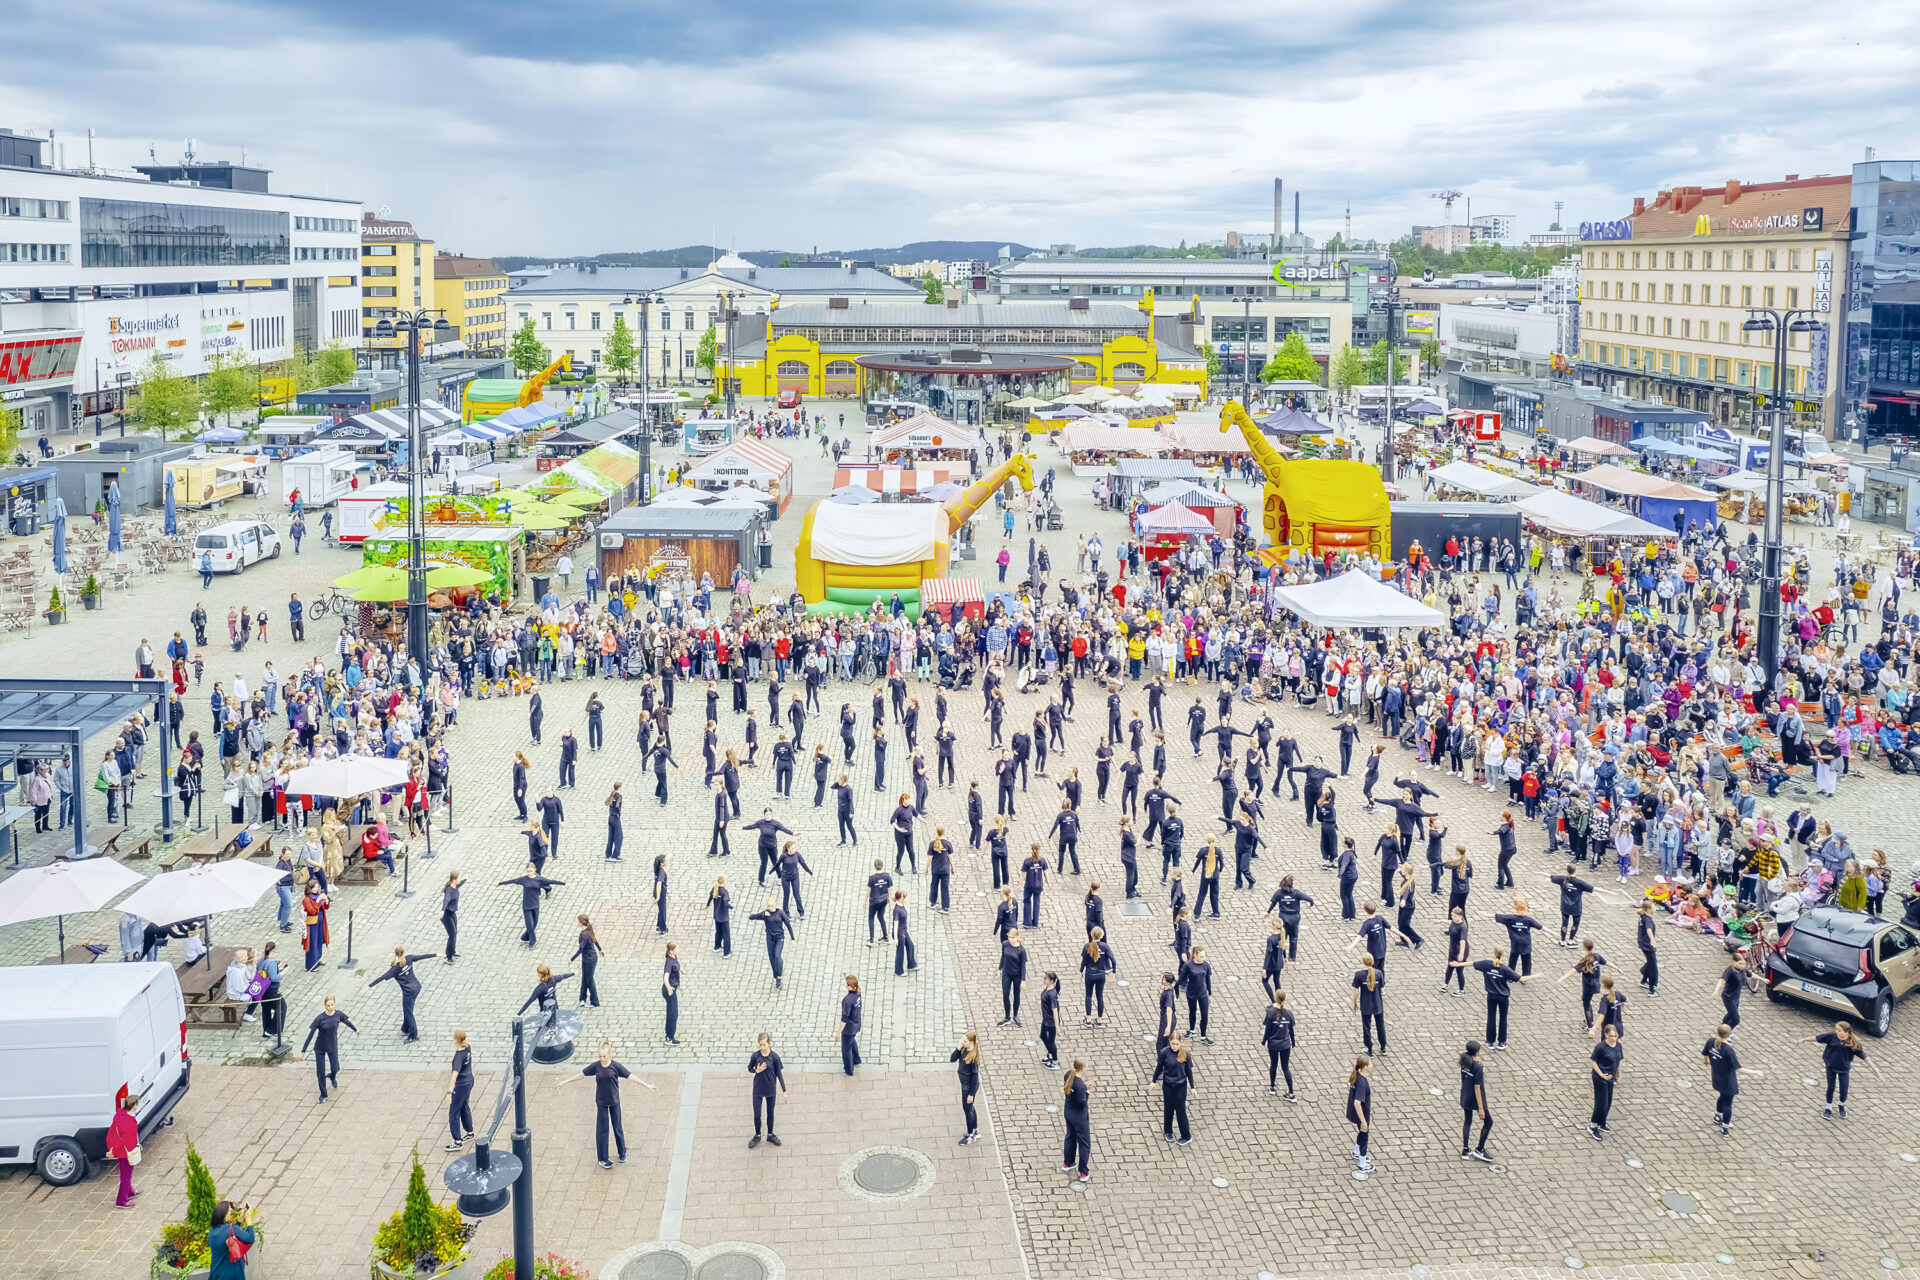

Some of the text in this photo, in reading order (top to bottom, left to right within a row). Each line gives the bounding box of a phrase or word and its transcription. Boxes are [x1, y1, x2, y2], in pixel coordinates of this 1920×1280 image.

[1579, 219, 1634, 240] CARLSON
[1766, 215, 1799, 228] ATLAS
[1285, 262, 1339, 281] aapeli
[1822, 261, 1830, 311] ATLAS
[111, 336, 156, 353] TOKMANNI
[1892, 446, 1908, 455] WC
